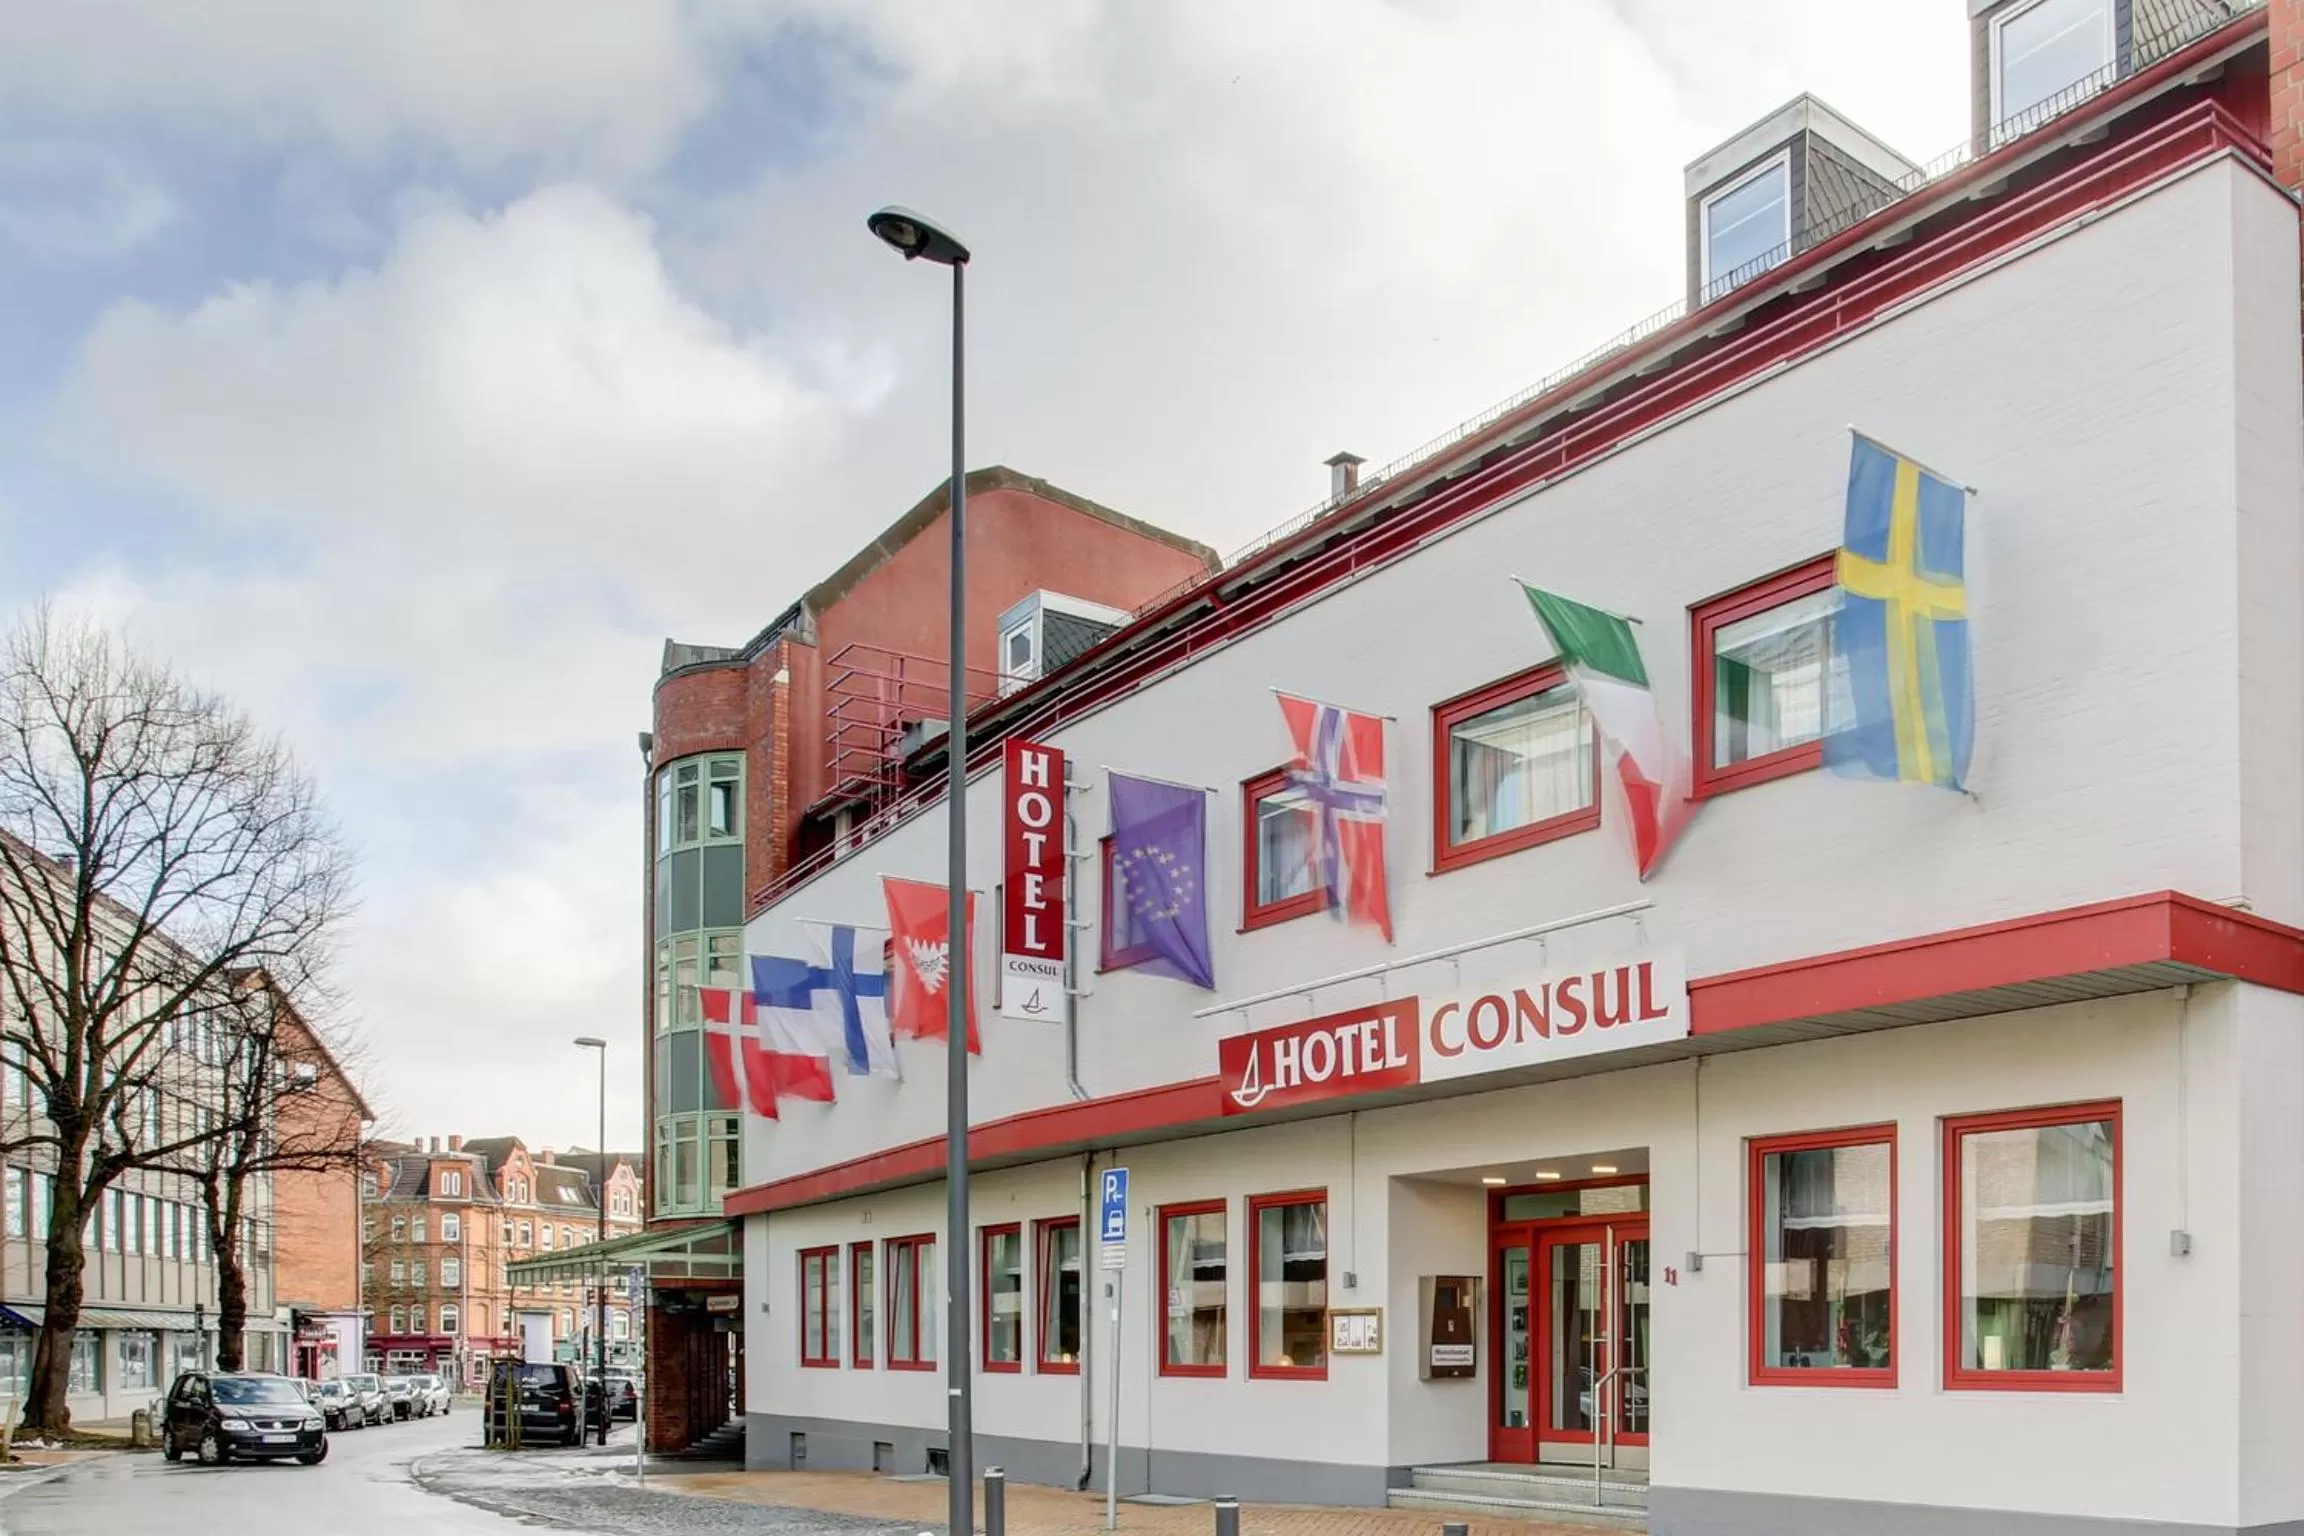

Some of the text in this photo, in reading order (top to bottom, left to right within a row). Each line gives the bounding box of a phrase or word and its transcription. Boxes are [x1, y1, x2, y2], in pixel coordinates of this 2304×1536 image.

[1017, 749, 1052, 952] HOTEL
[1009, 960, 1059, 977] CONSUL
[1273, 961, 1670, 1089] HOTEL CONSUL
[1105, 1174, 1118, 1204] P
